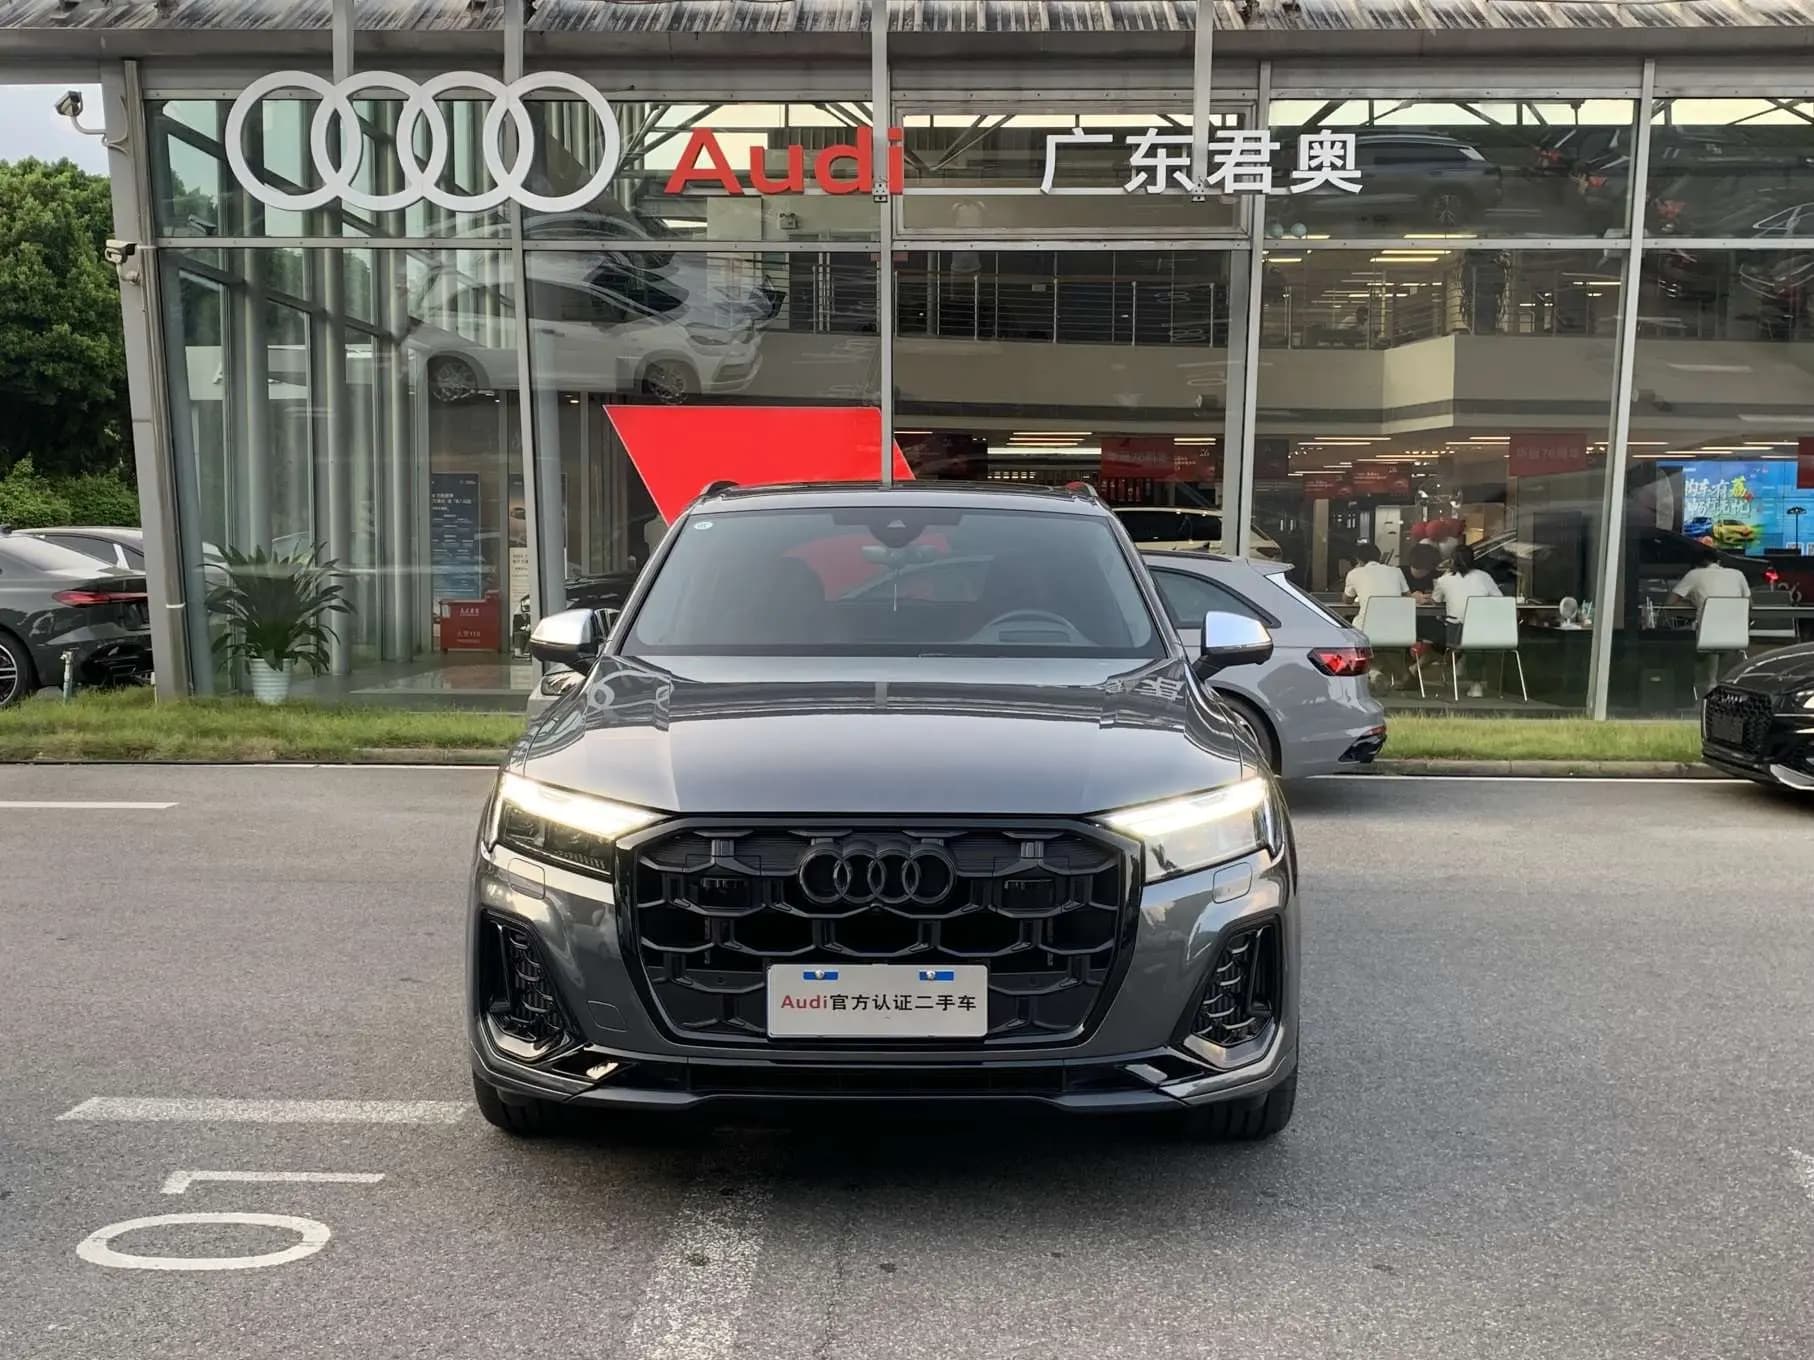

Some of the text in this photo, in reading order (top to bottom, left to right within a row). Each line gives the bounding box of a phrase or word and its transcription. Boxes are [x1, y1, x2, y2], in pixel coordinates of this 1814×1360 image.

[664, 125, 904, 195] Audi
[1040, 128, 1363, 194] 广东君奥
